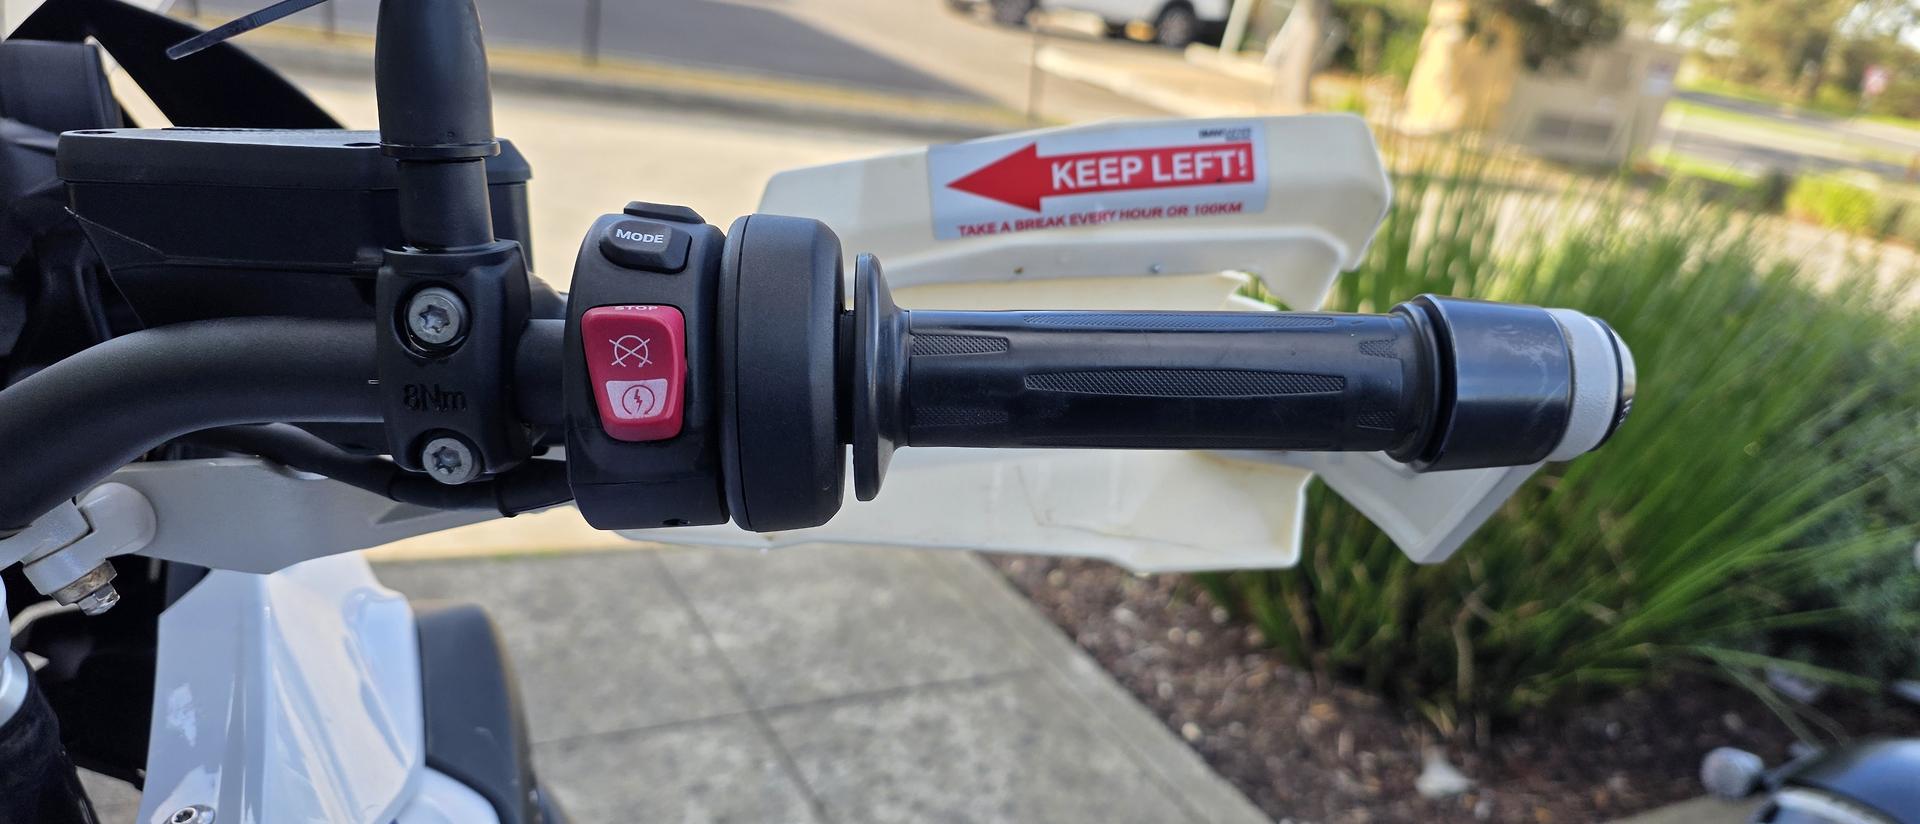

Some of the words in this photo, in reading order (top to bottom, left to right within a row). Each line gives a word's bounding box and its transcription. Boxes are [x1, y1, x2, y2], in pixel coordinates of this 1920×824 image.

[1051, 156, 1143, 190] KEEP
[1151, 149, 1248, 182] LEFT!
[957, 221, 996, 237] TAKE
[1000, 221, 1011, 232] A
[1015, 214, 1064, 232] BREAK
[1069, 209, 1116, 227] EVERY
[1119, 205, 1163, 220] HOUR
[1166, 204, 1188, 217] OR
[1194, 201, 1242, 216] 100KM
[616, 228, 664, 243] MODE
[403, 383, 467, 412] 8Nm
